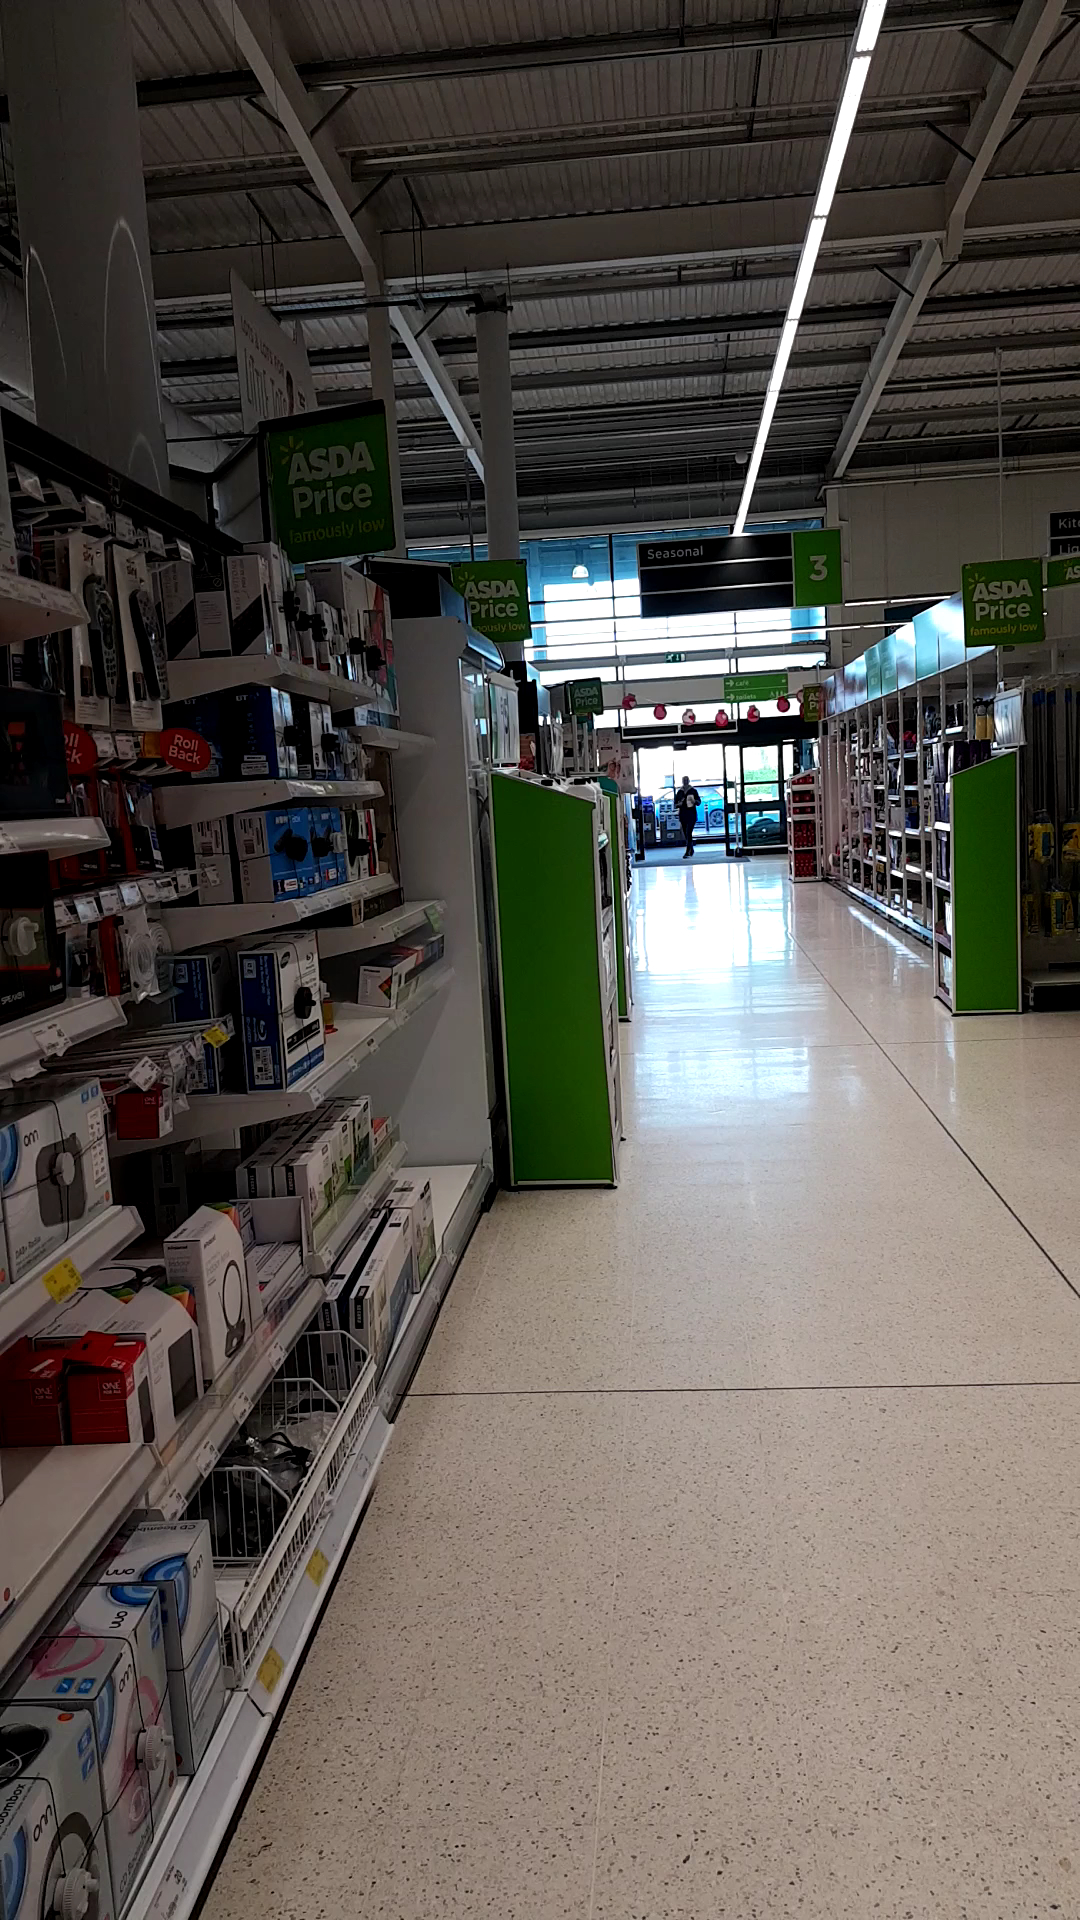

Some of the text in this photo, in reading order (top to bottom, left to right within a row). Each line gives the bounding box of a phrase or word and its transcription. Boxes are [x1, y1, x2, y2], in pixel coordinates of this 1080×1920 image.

[287, 440, 376, 485] ASDA
[292, 480, 373, 518] Price
[288, 518, 385, 544] famously low
[646, 545, 705, 560] Seasonal
[809, 554, 829, 581] 3
[463, 579, 520, 600] ASDA
[972, 578, 1034, 602] ASDA
[469, 599, 519, 618] Price
[974, 600, 1032, 621] Price
[476, 621, 526, 635] ously low
[970, 622, 1038, 637] famously low
[573, 686, 599, 699] ASDA
[735, 693, 757, 701] toilets
[574, 696, 599, 709] Price
[64, 732, 79, 748] ll
[173, 734, 199, 752] Roll
[168, 744, 201, 765] Back
[34, 1387, 53, 1396] ONE
[102, 1381, 121, 1391] ONE
